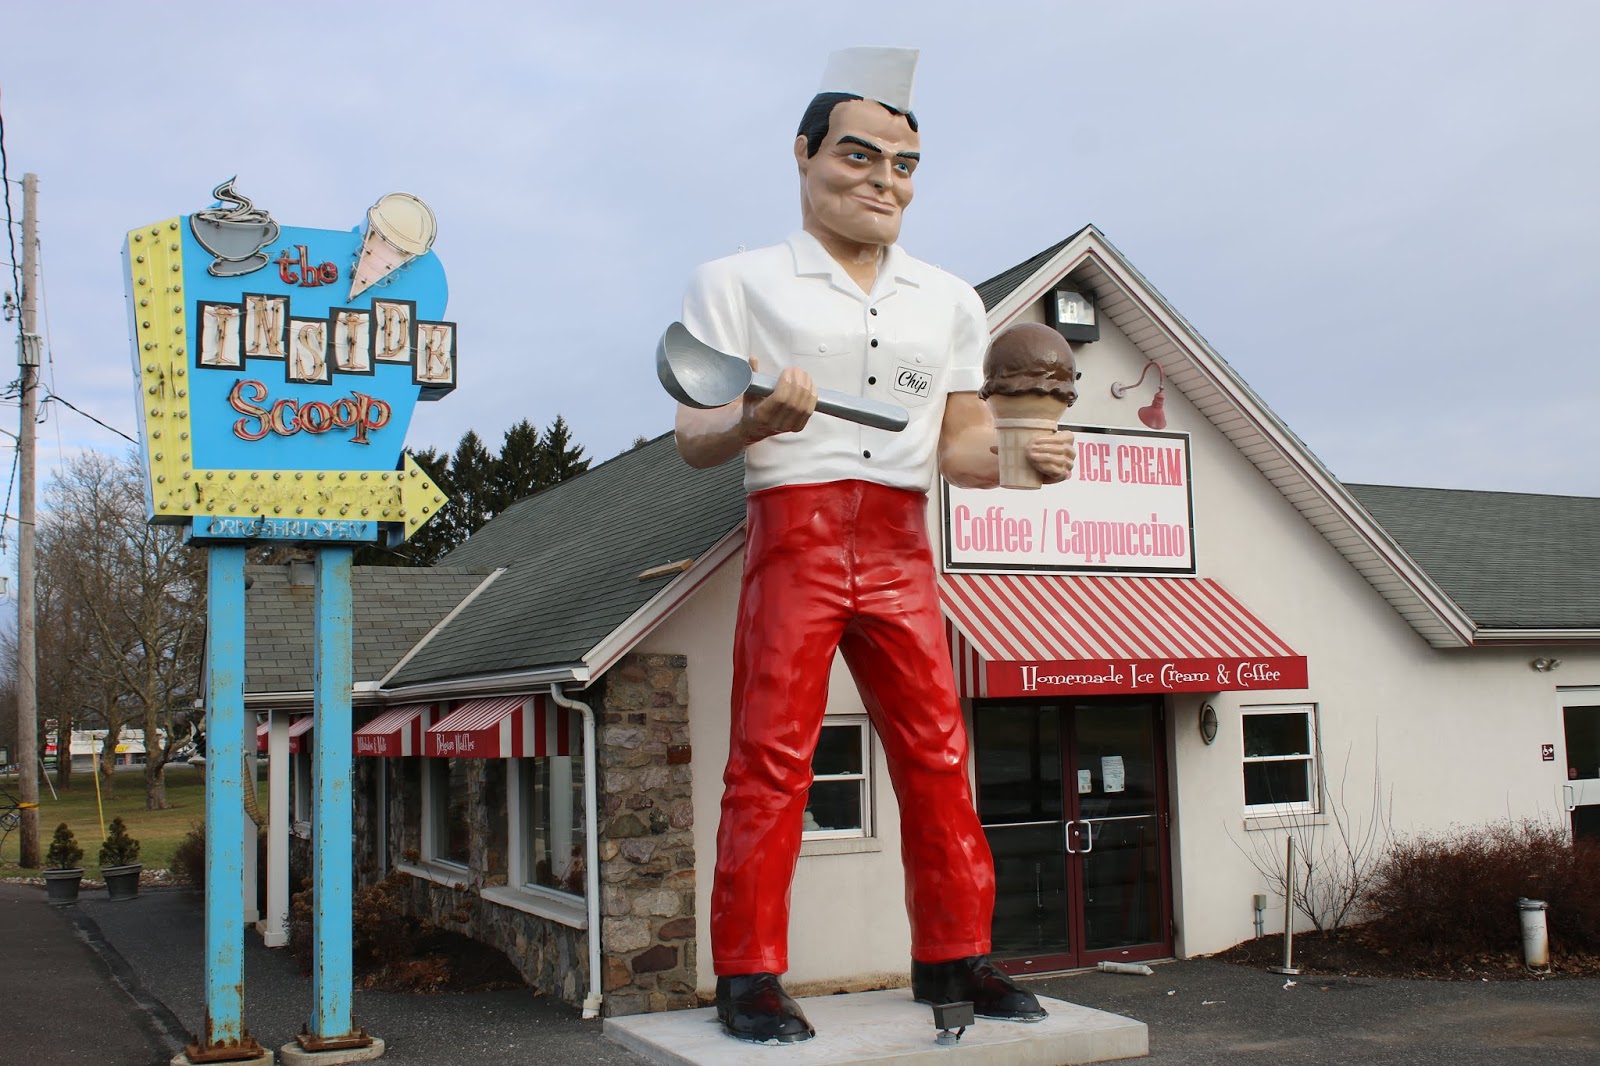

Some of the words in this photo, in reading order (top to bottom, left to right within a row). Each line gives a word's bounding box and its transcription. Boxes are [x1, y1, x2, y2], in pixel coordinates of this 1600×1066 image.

[274, 245, 339, 287] the
[202, 296, 454, 383] INSIDE
[898, 371, 928, 394] Chip
[229, 379, 392, 445] Scoop
[1078, 442, 1112, 482] ICE
[1117, 444, 1183, 486] CREAM
[954, 504, 1033, 553] Coffee
[1055, 508, 1185, 563] Cappuccino
[1020, 664, 1124, 691] Homemade
[1129, 663, 1155, 689] Ice
[1160, 663, 1210, 690] Cream
[1216, 663, 1231, 685] &
[1236, 662, 1281, 687] Coffee
[454, 733, 475, 755] Waffles
